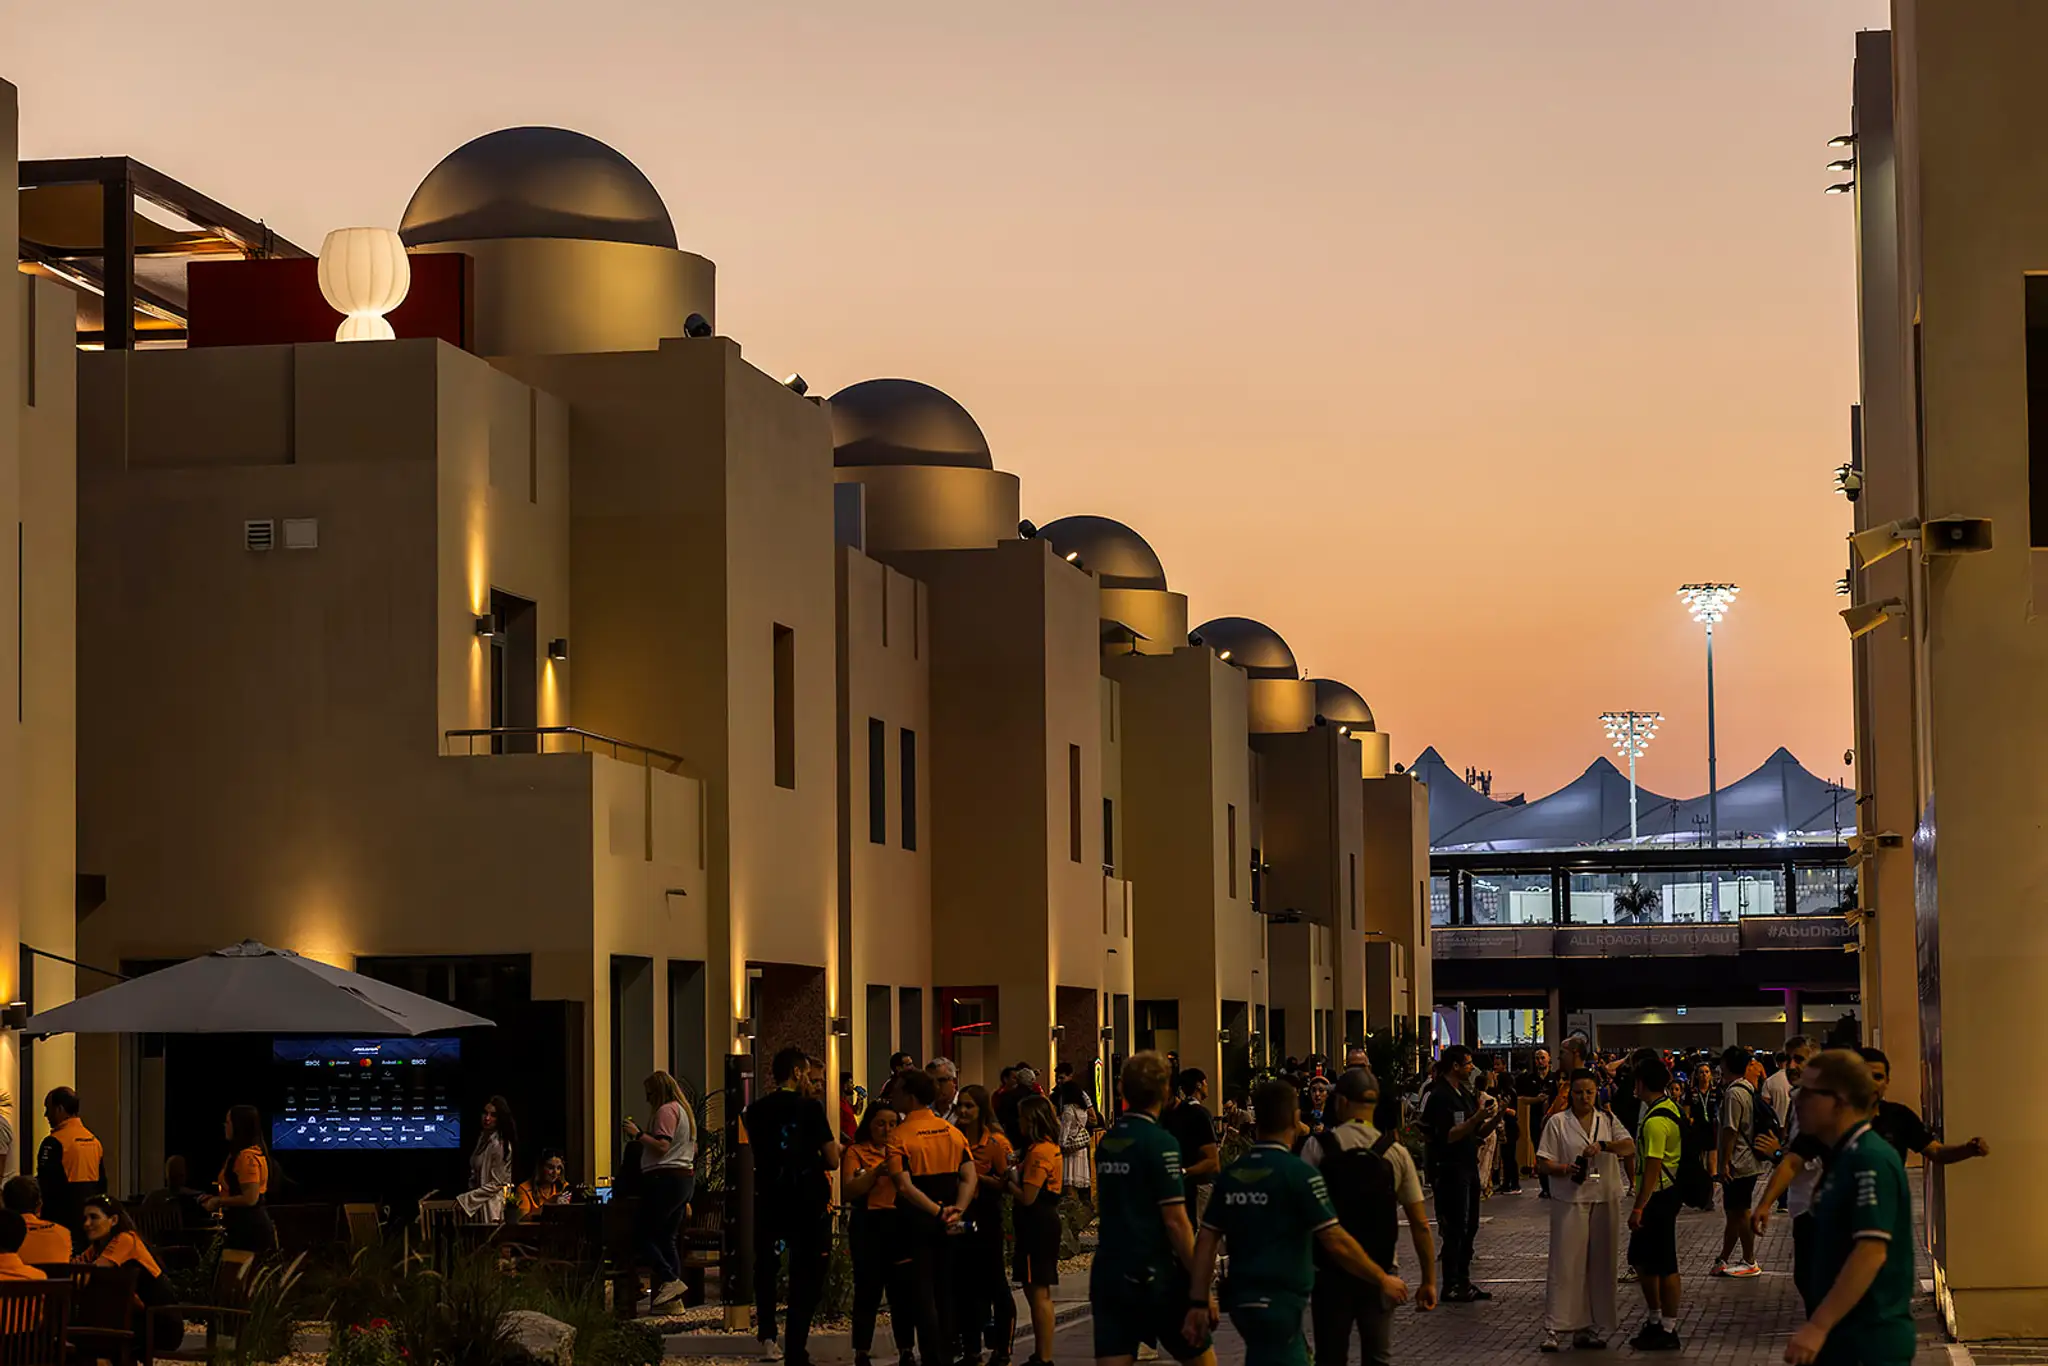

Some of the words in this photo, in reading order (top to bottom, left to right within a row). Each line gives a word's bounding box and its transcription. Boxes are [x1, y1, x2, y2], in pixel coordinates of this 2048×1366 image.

[1569, 934, 1595, 946] ALL
[1596, 934, 1641, 946] ROADS
[1643, 933, 1679, 945] LEAD
[1682, 933, 1699, 945] TO
[1701, 932, 1730, 944] ABU
